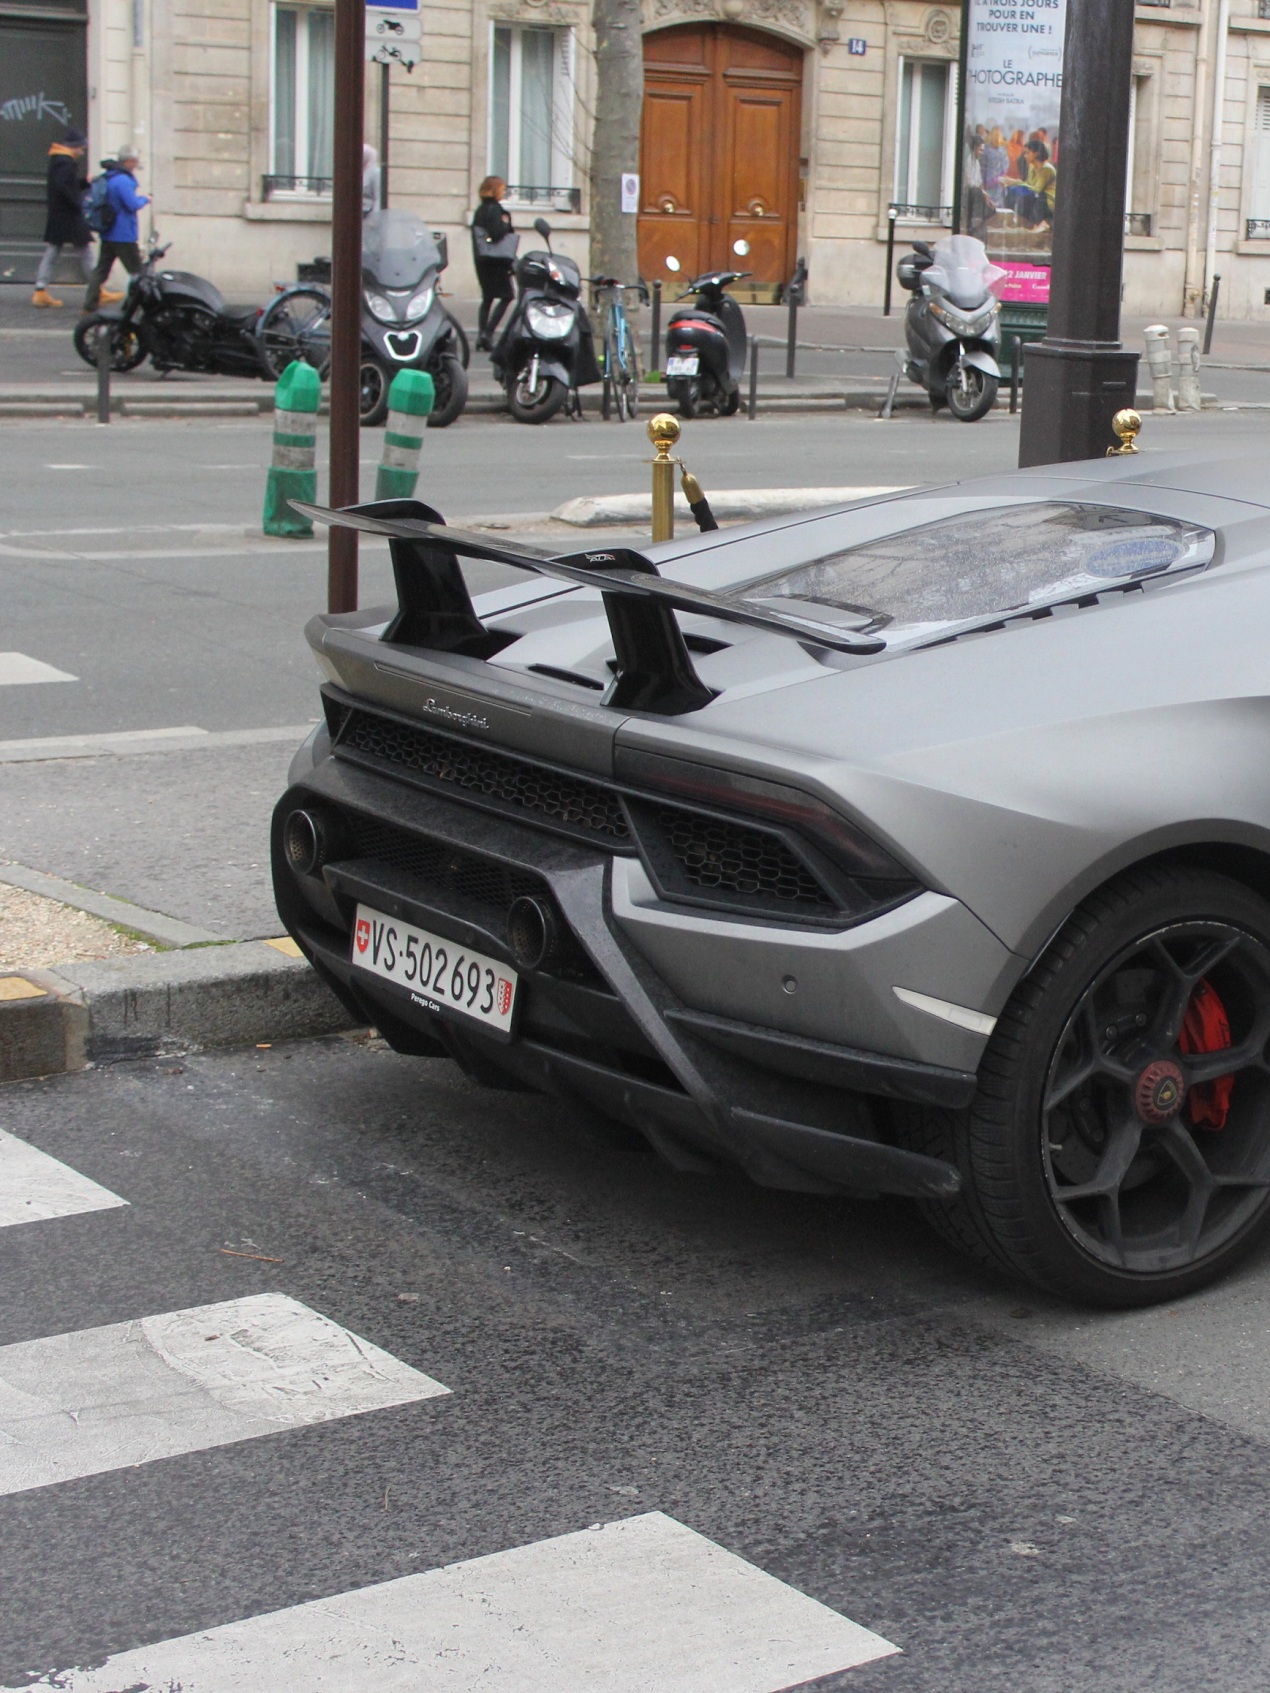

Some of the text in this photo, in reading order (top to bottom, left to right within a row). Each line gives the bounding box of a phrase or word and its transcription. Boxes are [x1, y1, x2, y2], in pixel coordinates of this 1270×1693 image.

[1020, 0, 1059, 8] JOURS
[989, 10, 1034, 20] POUR EN
[976, 22, 1018, 32] TROUVER
[1021, 23, 1045, 34] UNE
[852, 39, 864, 53] 14
[1003, 60, 1012, 68] LE
[1015, 271, 1047, 279] JANVIER
[422, 698, 489, 729] Lamborghini
[411, 992, 440, 1012] Perego Cars
